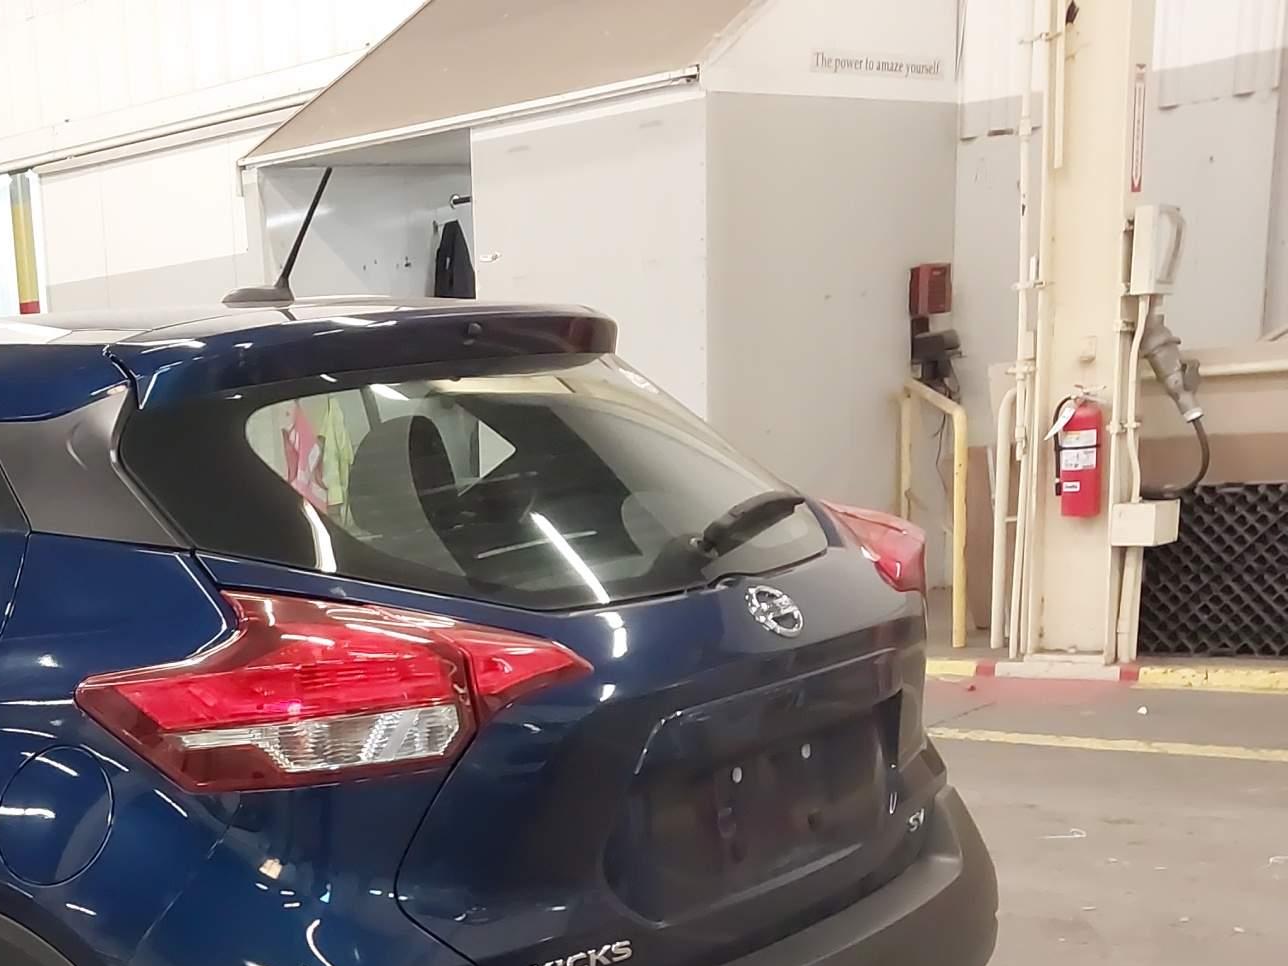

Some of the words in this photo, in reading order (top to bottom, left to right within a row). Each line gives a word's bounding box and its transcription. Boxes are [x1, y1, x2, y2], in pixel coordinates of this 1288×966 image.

[814, 52, 832, 69] The
[834, 57, 864, 73] power
[865, 57, 874, 71] to
[876, 60, 904, 73] amaze
